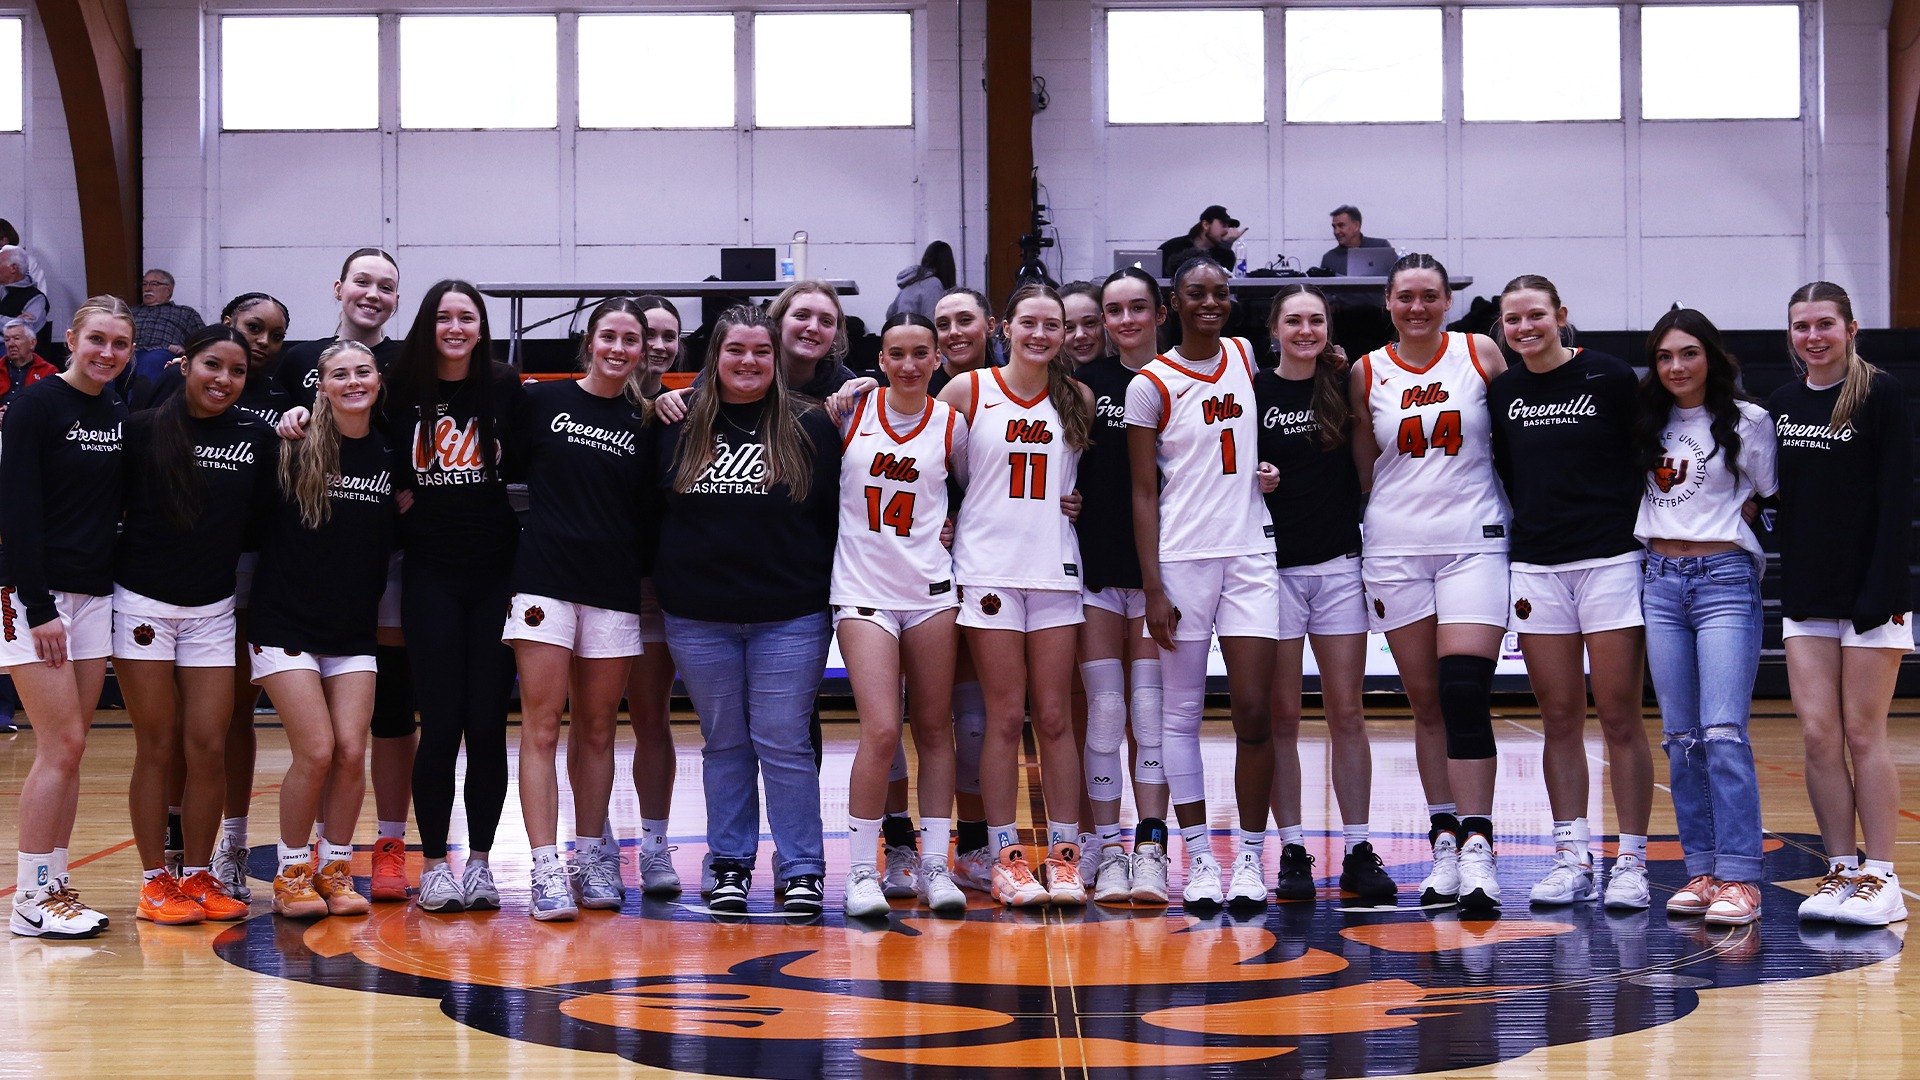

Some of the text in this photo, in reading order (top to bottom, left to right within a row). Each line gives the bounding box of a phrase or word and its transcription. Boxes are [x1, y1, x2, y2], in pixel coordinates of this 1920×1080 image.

[1202, 393, 1243, 425] Ville
[1400, 382, 1450, 410] Ville
[1508, 394, 1598, 420] Greenville
[1263, 406, 1316, 429] Green
[1283, 424, 1320, 435] BASKET
[1523, 417, 1579, 427] BASKETBALL
[66, 420, 123, 443] Greenvil
[551, 412, 636, 455] Greenville
[1005, 418, 1054, 444] Ville
[1397, 410, 1463, 458] 44
[1783, 438, 1831, 450] BASKETBALL
[193, 441, 255, 465] enville
[412, 416, 502, 473] Vill
[567, 435, 622, 457] BASKETBALL
[1220, 428, 1237, 475] 1
[195, 460, 238, 471] KETBALL
[870, 452, 920, 483] Ville
[1678, 434, 1706, 489] UNIVERSITY
[326, 470, 392, 495] reenville
[416, 470, 502, 486] BASKETBA
[1008, 452, 1048, 500] 11
[864, 485, 916, 537] 14
[1647, 488, 1696, 508] SKETBALL
